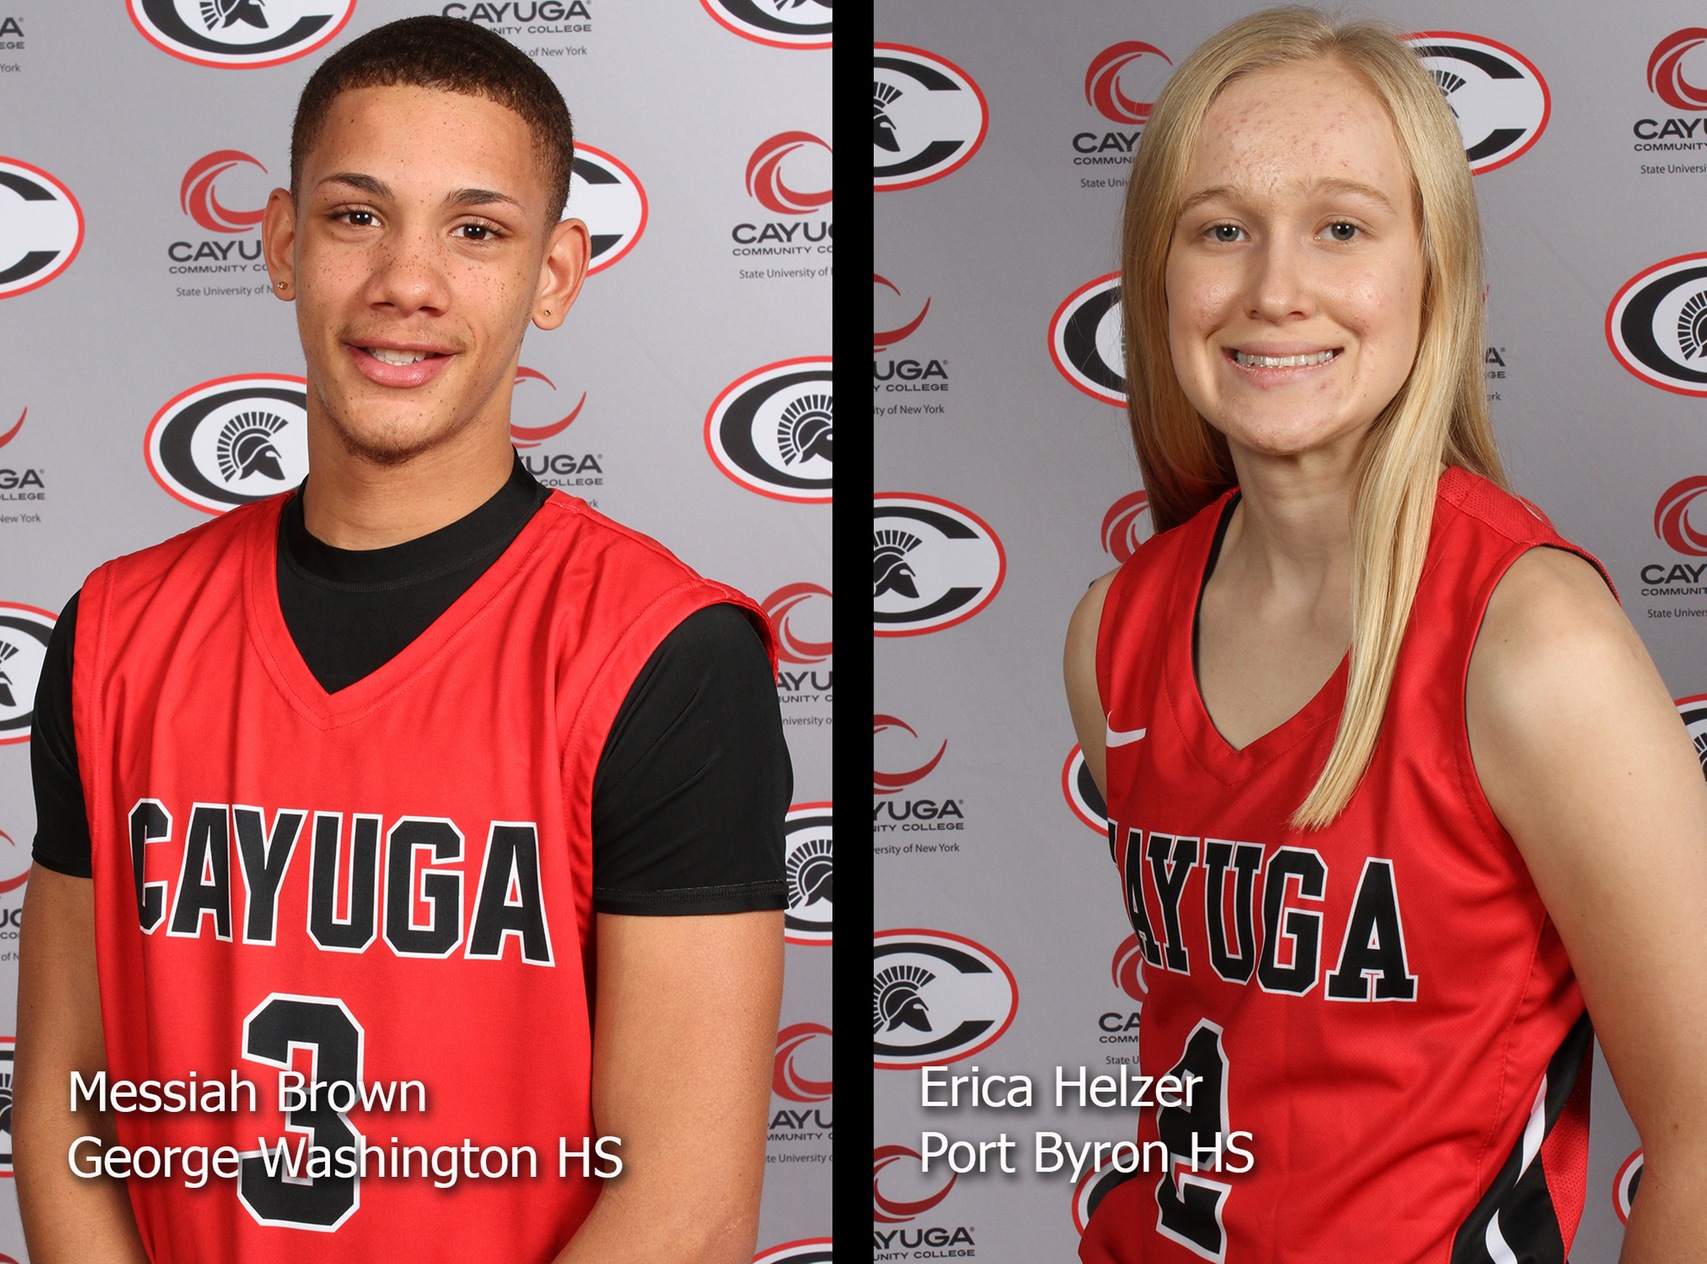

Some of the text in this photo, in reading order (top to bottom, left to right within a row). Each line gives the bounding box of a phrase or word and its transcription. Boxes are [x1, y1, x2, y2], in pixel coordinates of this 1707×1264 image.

[528, 24, 592, 34] COLLEGE
[529, 46, 587, 57] of New York
[1633, 118, 1707, 140] CAY
[1072, 132, 1142, 153] CAY
[1634, 142, 1707, 152] COMMUNIT
[1073, 156, 1135, 165] COMMUN
[1640, 163, 1707, 174] State Universi
[1080, 178, 1106, 188] State
[732, 221, 833, 244] CAYU
[168, 240, 262, 262] CAYU
[732, 246, 812, 256] COMMUNITY
[169, 264, 248, 274] COMMUNITY
[739, 266, 829, 279] State University of
[176, 287, 201, 297] State
[203, 285, 251, 297] University
[254, 284, 265, 295] of
[874, 359, 949, 381] UGA
[886, 384, 949, 392] COLLEGE
[887, 404, 898, 415] of
[900, 405, 921, 414] New
[923, 404, 945, 414] York
[520, 454, 603, 476] UGA
[541, 478, 603, 487] COLLEGE
[0, 492, 45, 501] LLEGE
[20, 513, 41, 523] York
[1640, 564, 1707, 585] CAY
[1641, 587, 1707, 596] COMMUNIT
[1647, 608, 1707, 618] State Univer
[778, 671, 833, 691] AYU
[779, 694, 820, 703] UNITY
[782, 716, 824, 727] niversity
[902, 822, 964, 832] COLLEGE
[874, 842, 960, 856] ersity of New York
[128, 798, 555, 967] CAYUGA
[1107, 817, 1418, 1002] AYUGA
[1, 951, 11, 961] of
[1106, 1055, 1130, 1065] State
[237, 992, 364, 1233] 3
[768, 1109, 833, 1130] AYU
[767, 1132, 823, 1141] MMUNITY
[778, 1153, 827, 1164] University
[874, 1227, 975, 1250] YUGA
[874, 1249, 975, 1261] UNITY COLLEGE
